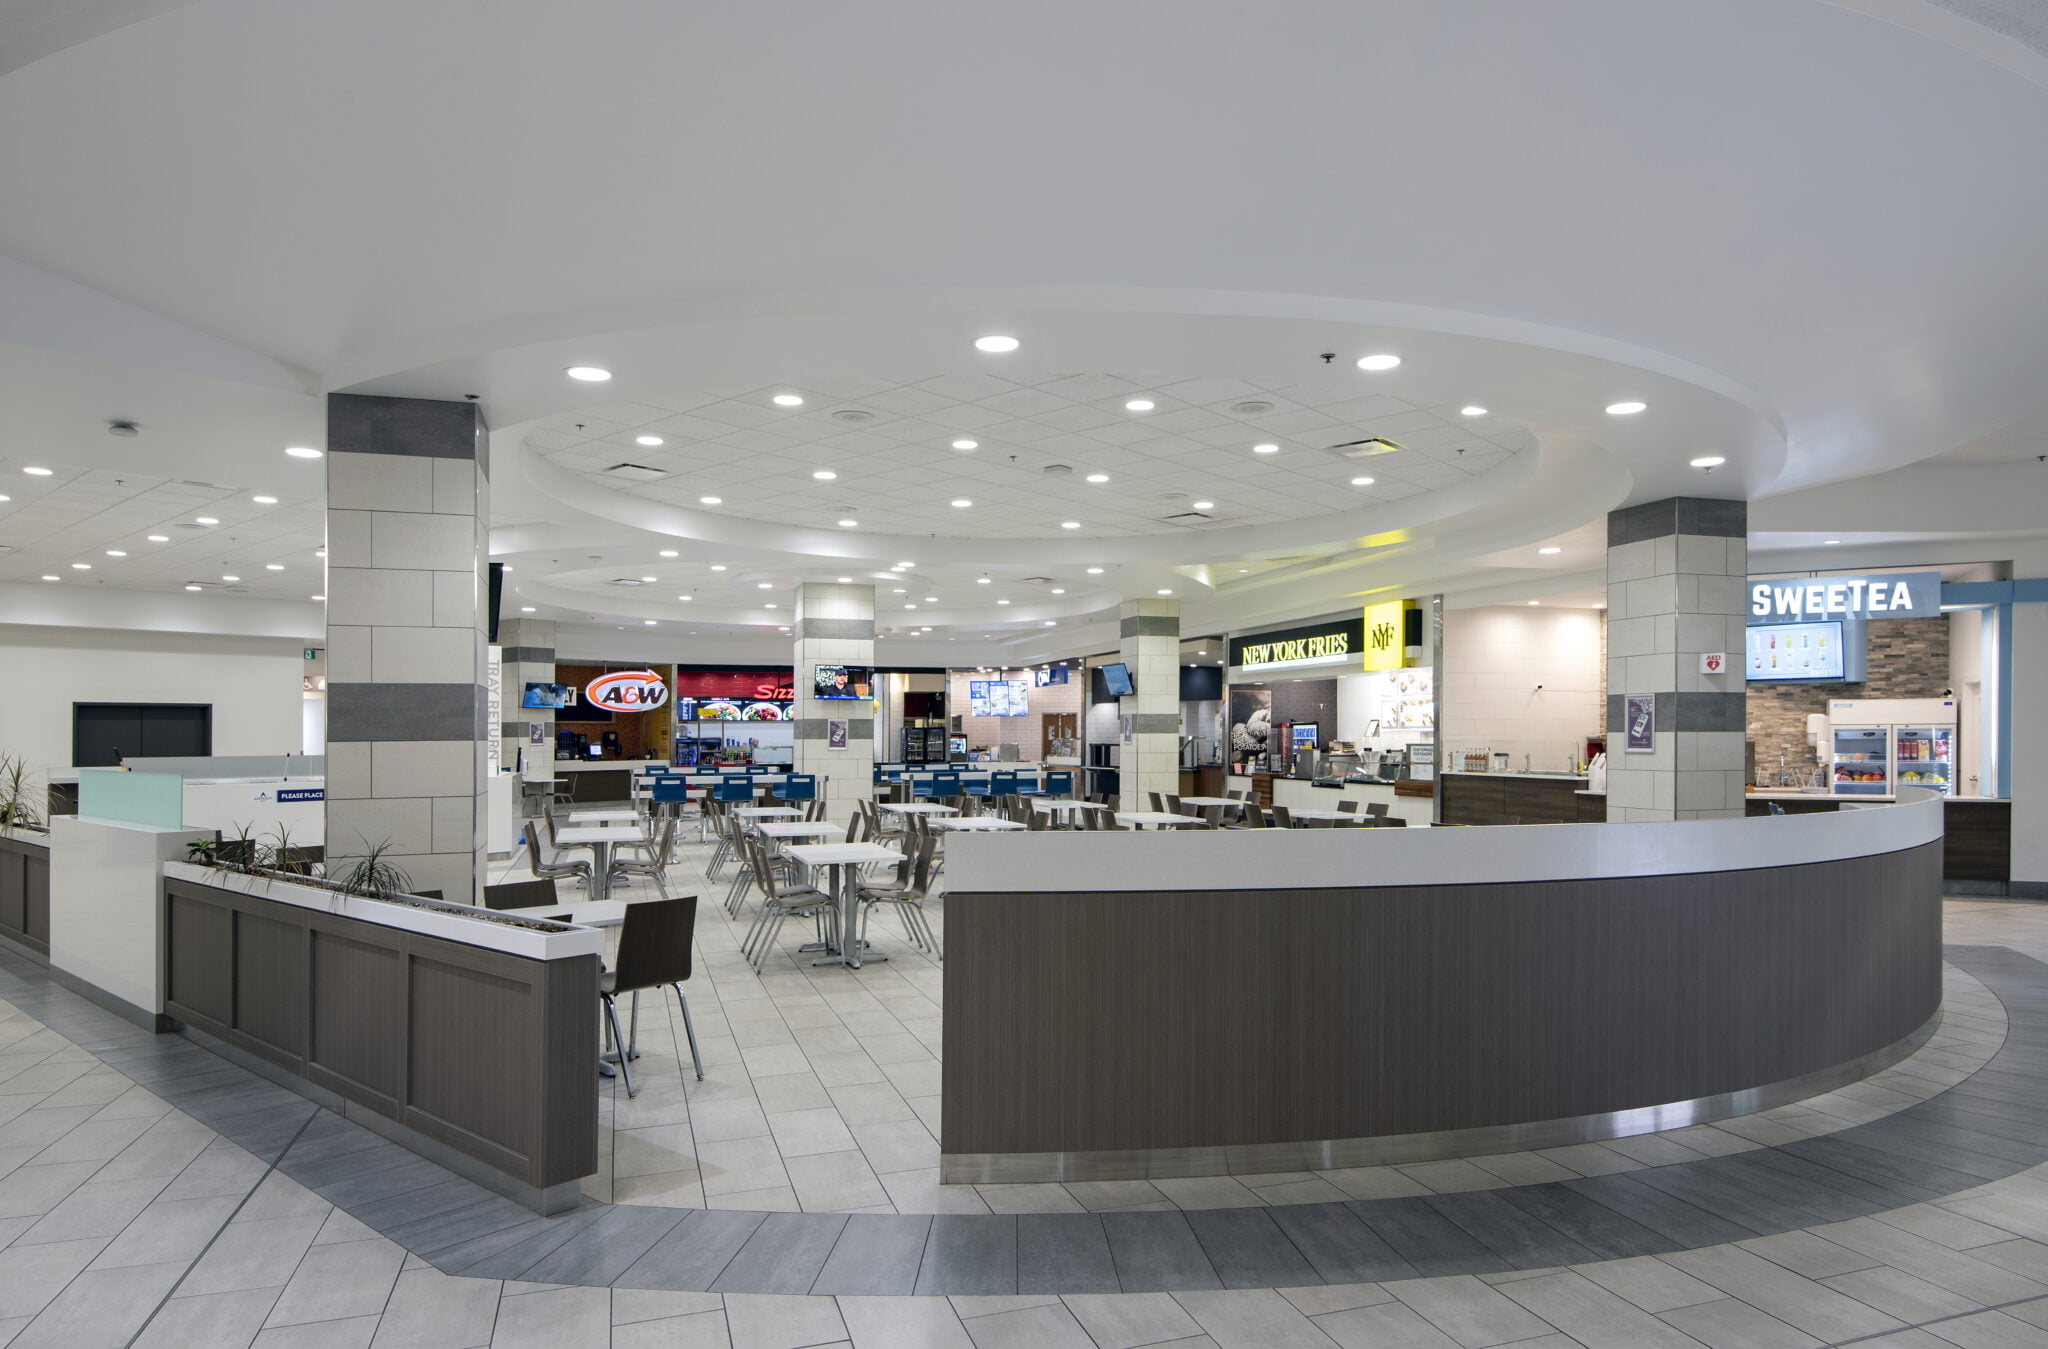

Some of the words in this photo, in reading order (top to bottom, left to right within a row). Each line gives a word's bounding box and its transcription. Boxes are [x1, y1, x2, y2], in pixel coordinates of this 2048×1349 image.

[1242, 643, 1271, 665] NEW
[1271, 638, 1307, 662] YORK
[1307, 631, 1348, 658] FRIES
[1371, 622, 1395, 650] NYF
[488, 659, 500, 695] TRAY
[602, 685, 665, 704] A&W
[488, 700, 500, 760] RETURN
